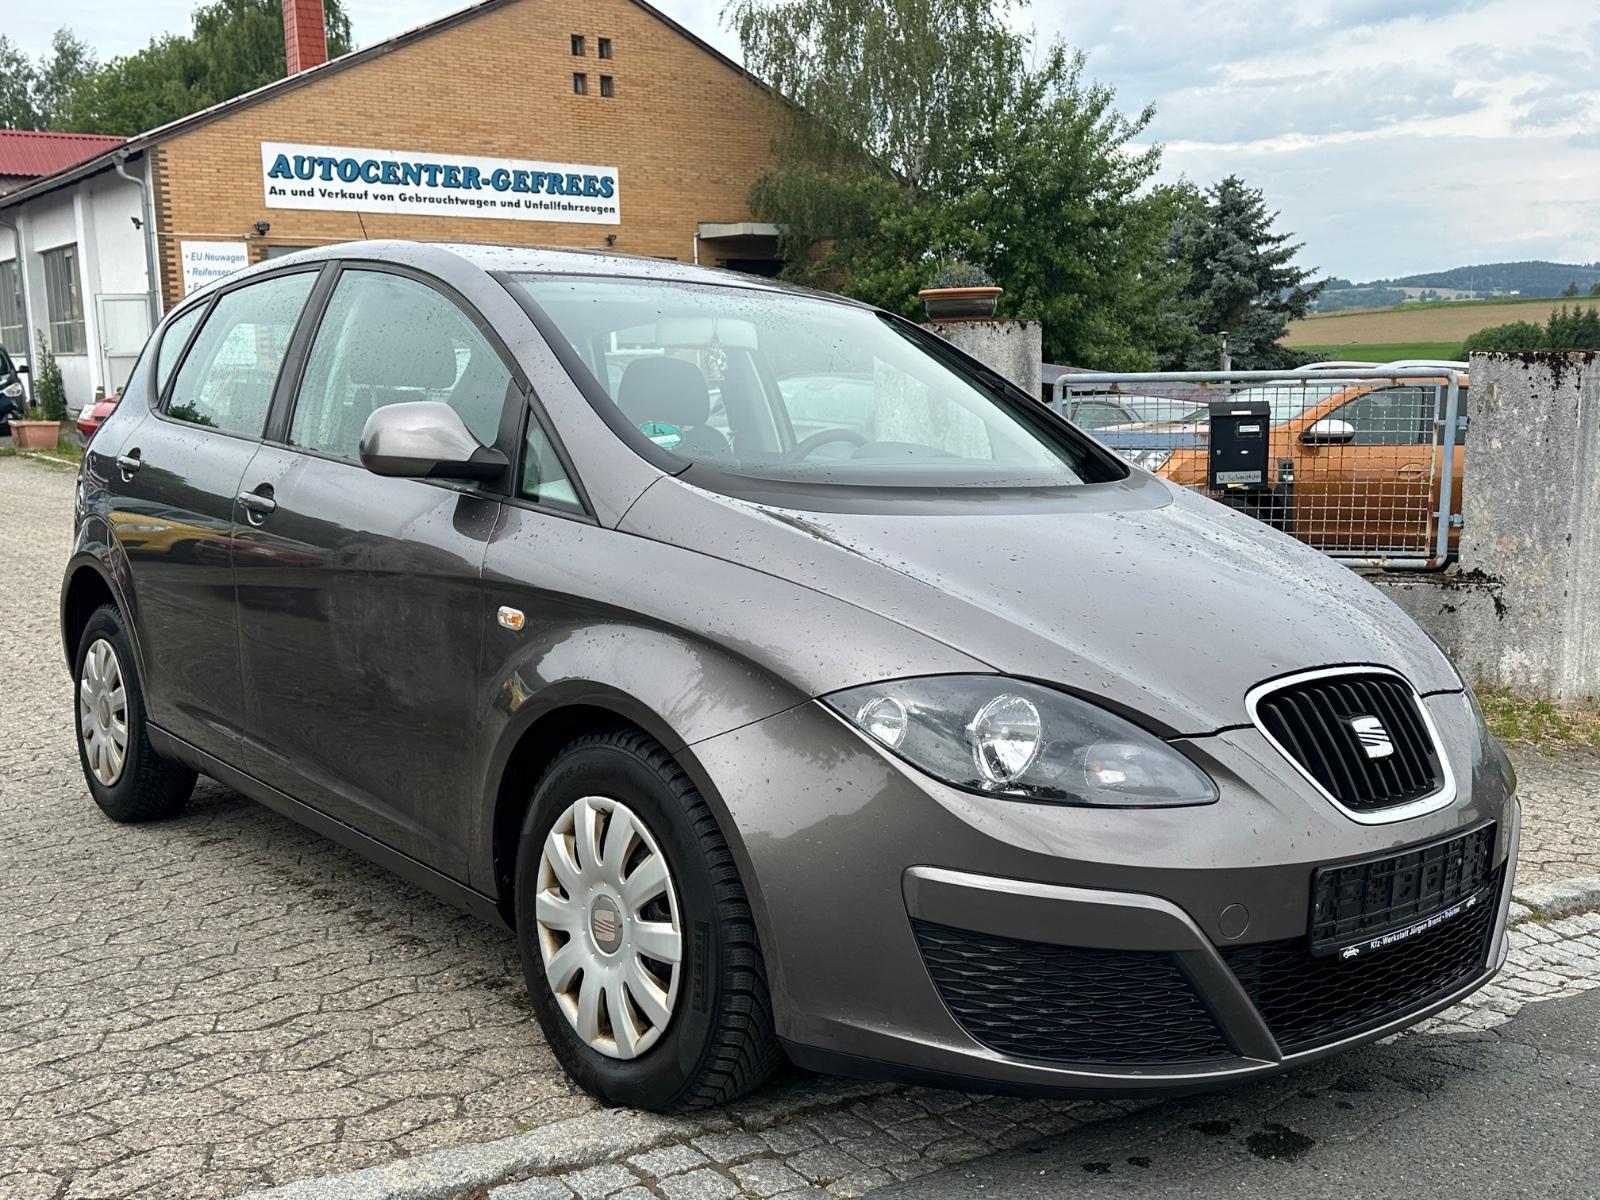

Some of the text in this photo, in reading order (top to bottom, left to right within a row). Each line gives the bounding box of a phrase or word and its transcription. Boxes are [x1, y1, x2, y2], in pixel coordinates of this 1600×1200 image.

[267, 153, 615, 199] AUTOCENTER-GEFREES
[268, 186, 616, 215] An und Verkauf von Gebrauchtwagen und Unfallfahrzeugen
[191, 252, 245, 263] EU Neuwagen
